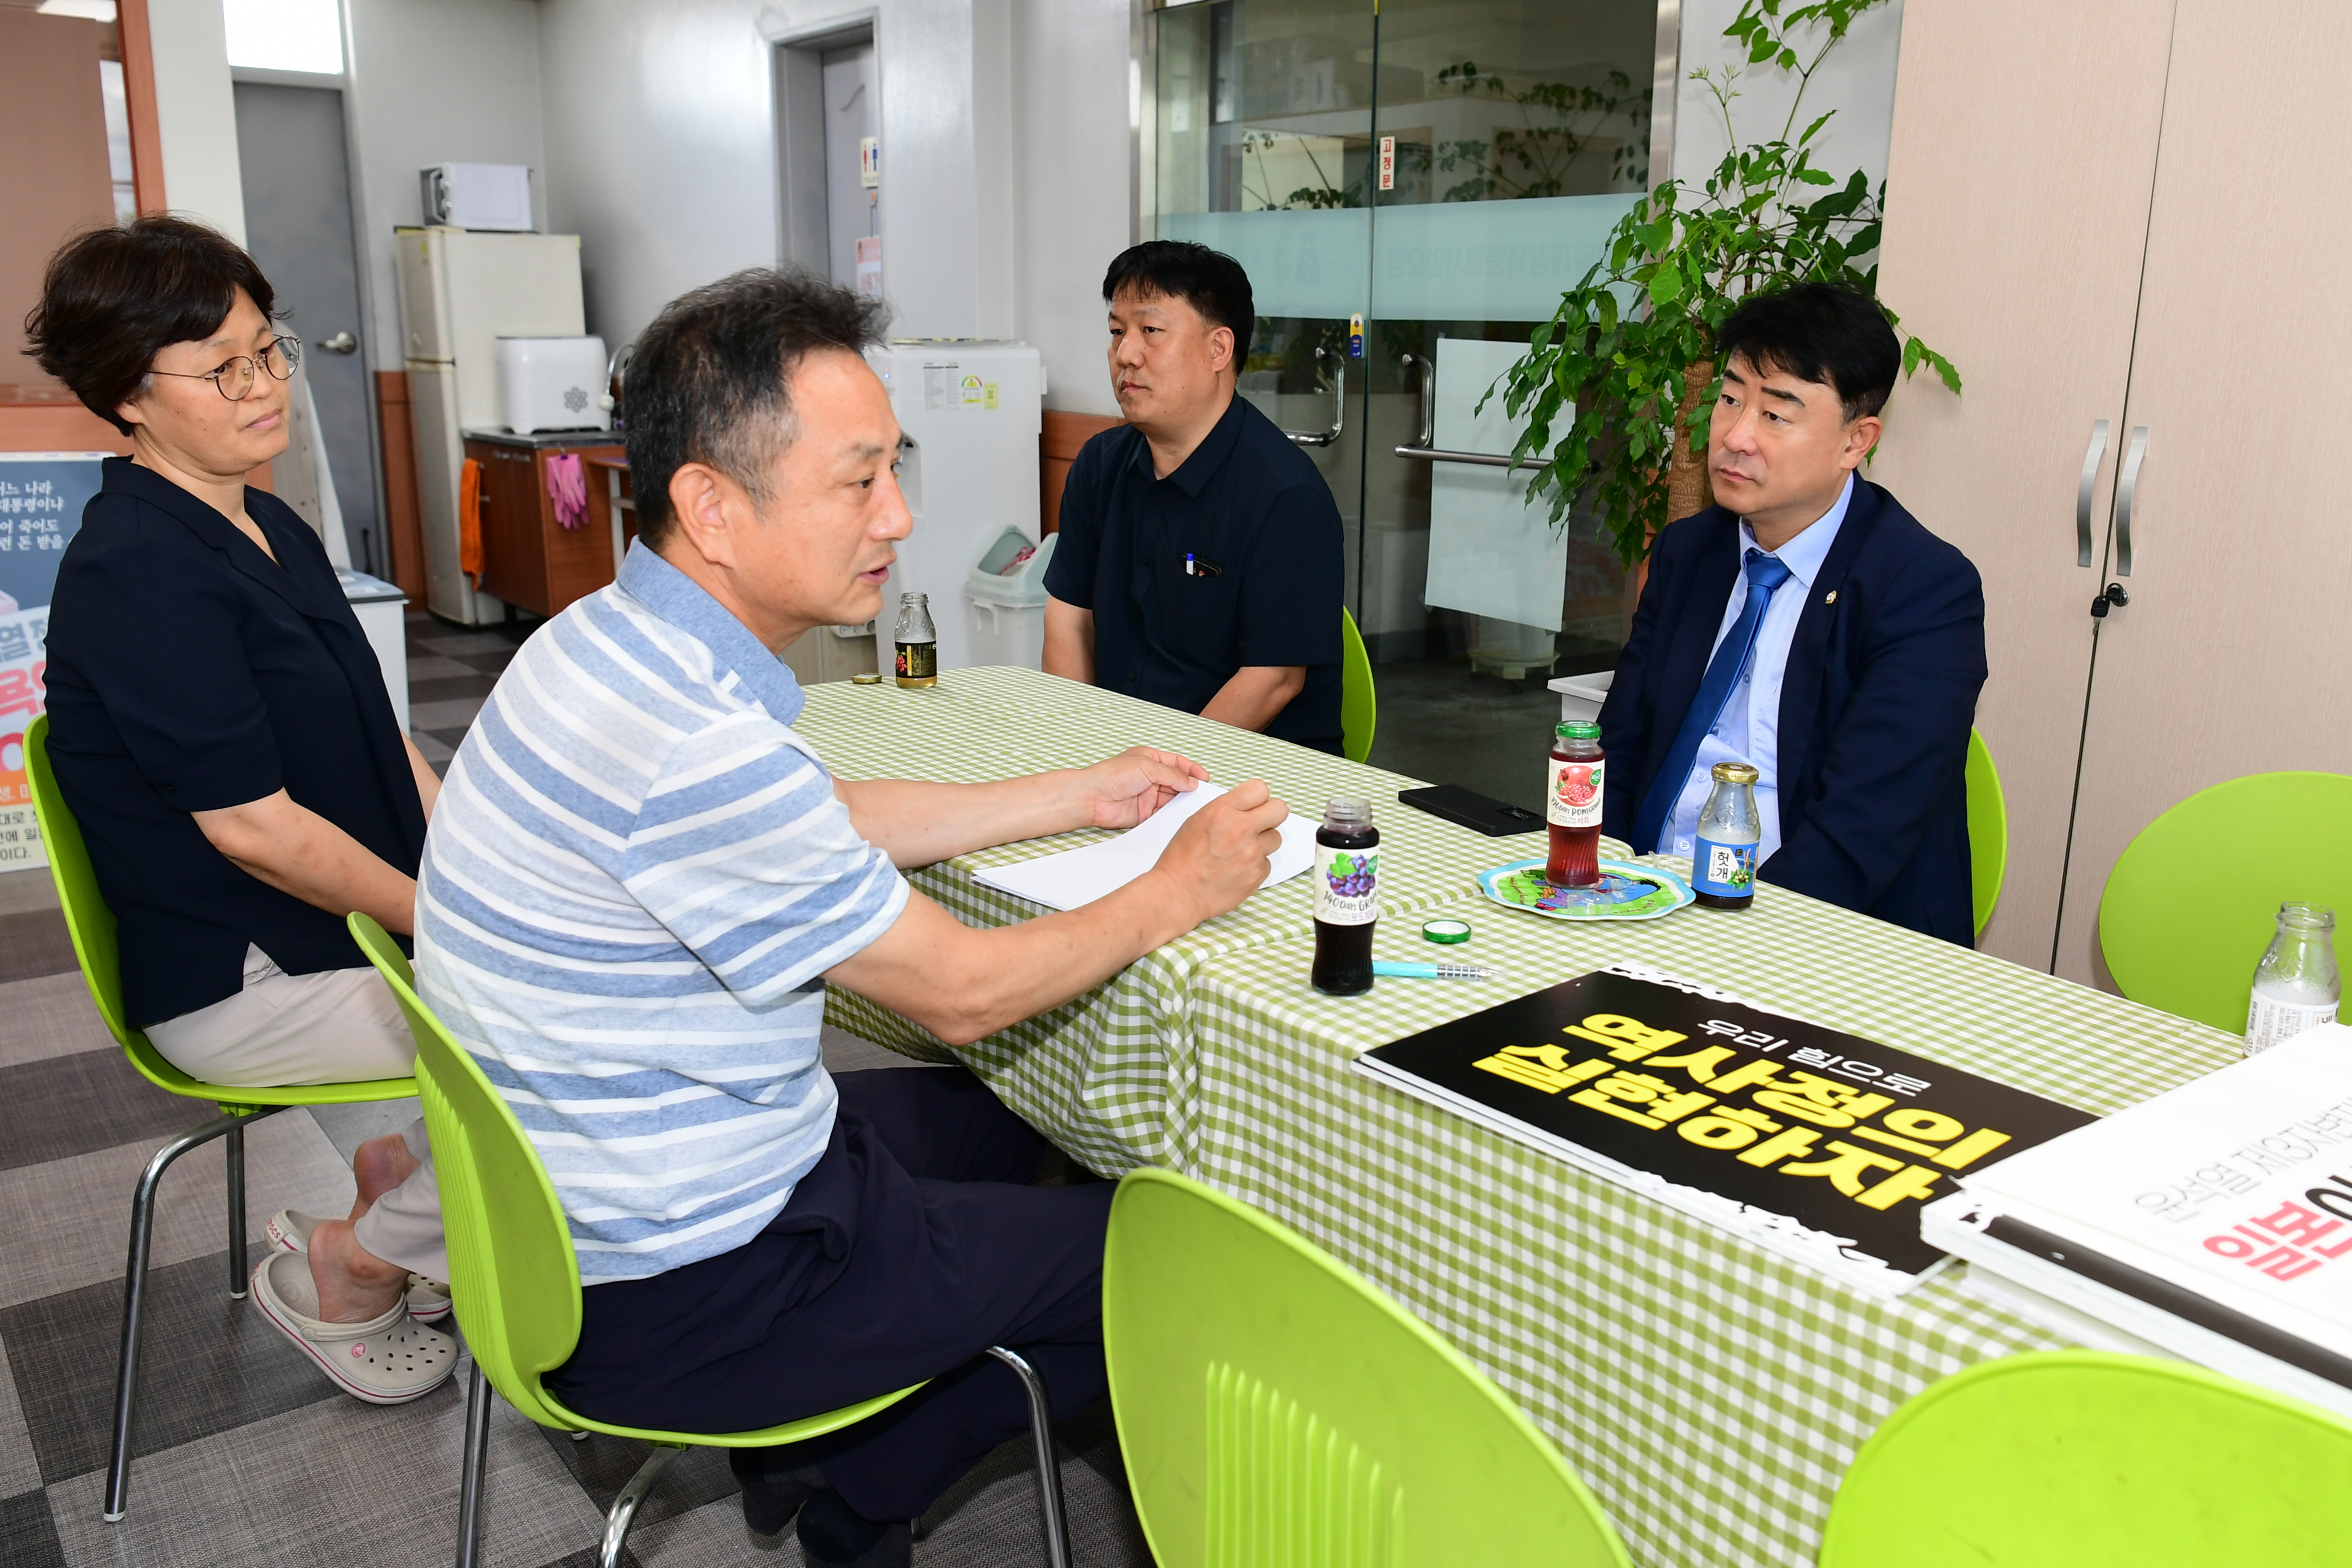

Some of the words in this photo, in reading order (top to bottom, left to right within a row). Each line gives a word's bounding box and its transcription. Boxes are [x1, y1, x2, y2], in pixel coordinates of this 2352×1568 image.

[25, 480, 53, 496] 나라
[18, 518, 59, 533] 죽어도
[24, 828, 42, 841] 일
[1716, 851, 1729, 879] 헛개
[1698, 1020, 1788, 1051] 우리
[1787, 1046, 1931, 1096] 힘으로
[1562, 1014, 2012, 1170] 역사정의
[1472, 1044, 1942, 1210] 실현하자
[2135, 1161, 2262, 1223] 윤석열
